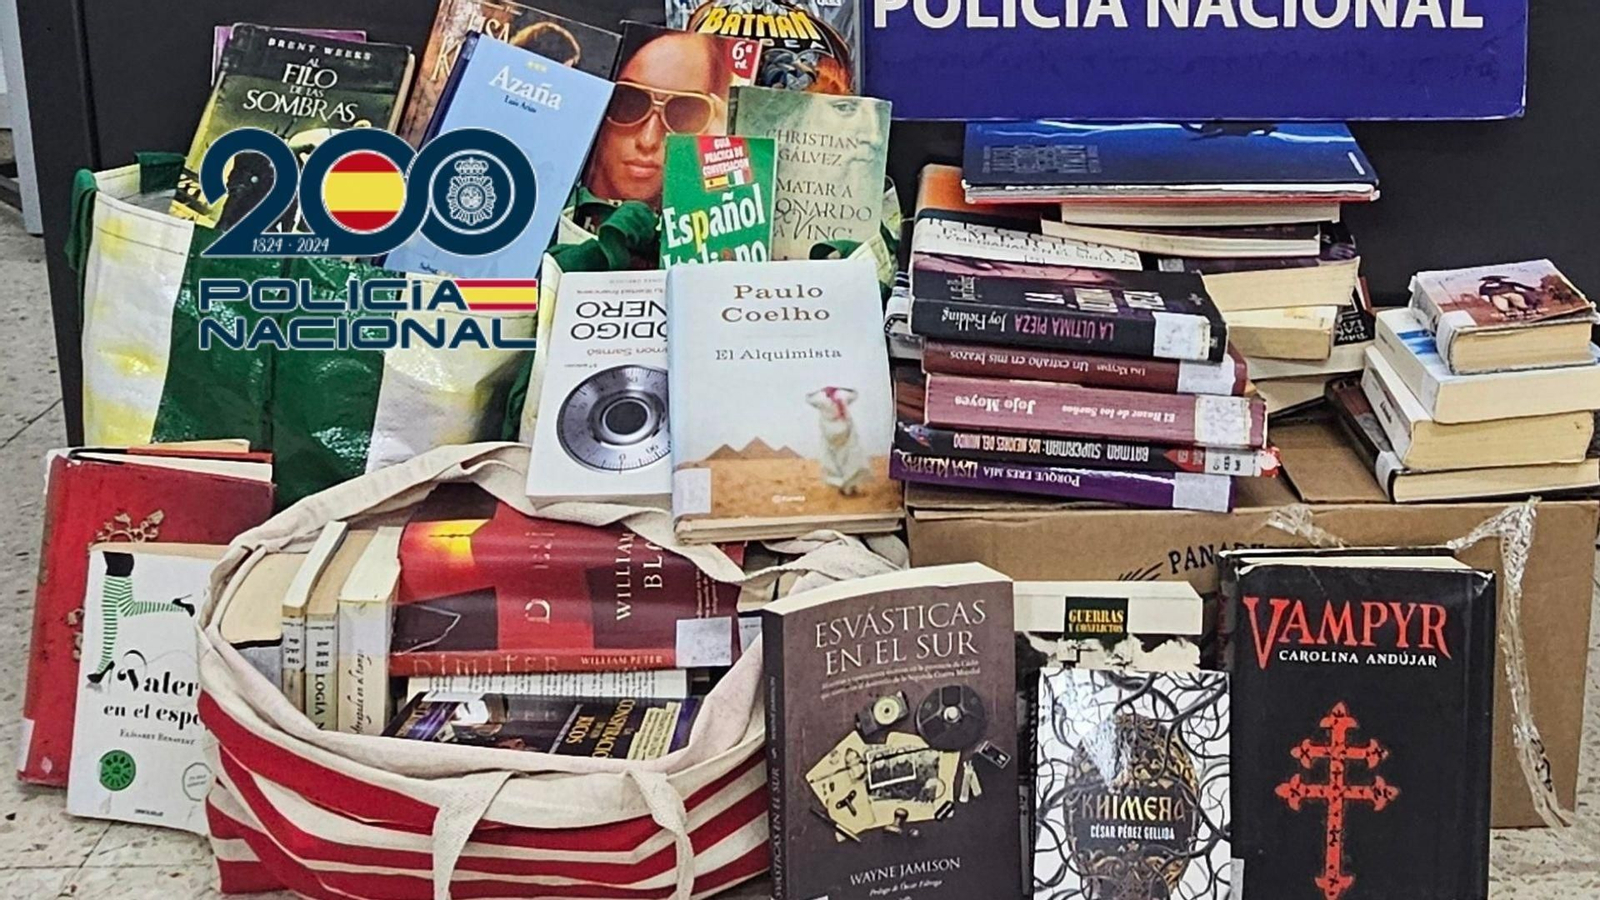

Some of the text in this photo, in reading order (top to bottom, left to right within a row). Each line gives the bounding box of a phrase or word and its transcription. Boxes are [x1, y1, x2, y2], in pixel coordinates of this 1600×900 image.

[1147, 0, 1484, 28] NACIONAL
[699, 7, 821, 40] BATMAN
[268, 37, 373, 61] BRENT WEEKS
[305, 57, 320, 67] AL
[282, 63, 338, 90] FILO
[306, 88, 325, 98] LAS
[489, 65, 562, 110] Azaña
[243, 90, 359, 122] SOMBRAS
[766, 128, 859, 150] CHRISTIAN
[778, 146, 843, 167] GÁLVEZ
[776, 177, 853, 198] MATAR A
[662, 182, 766, 254] Español
[793, 212, 853, 241] VINC
[733, 283, 824, 300] Paulo
[721, 306, 831, 323] Coelho
[941, 308, 1114, 343] LA ÚLTIMA PIEZA Joy Fielding
[715, 348, 842, 362] El Alquimista
[950, 349, 987, 366] brazos
[988, 354, 1009, 366] mis
[1011, 356, 1026, 366] en
[1028, 356, 1070, 371] extraño
[1072, 361, 1089, 373] Un
[954, 394, 1001, 414] Moyes
[1003, 396, 1036, 414] Jojo
[1117, 407, 1130, 420] de
[1106, 445, 1149, 463] BATMAN
[1006, 468, 1033, 482] ERES
[1035, 470, 1081, 488] PORQUE
[815, 599, 987, 649] ESVÁSTICAS
[1067, 608, 1125, 625] GUERRAS
[1243, 596, 1451, 670] VAMPYR
[580, 654, 628, 667] WILLIAM
[630, 654, 663, 665] PETER
[825, 629, 980, 676] EN EL SUR
[1279, 649, 1439, 668] CAROLINA ANDÚJAR
[103, 705, 126, 717] en
[133, 703, 150, 719] el
[1090, 822, 1116, 839] CÉSAR
[850, 857, 961, 886] WAYNE JAMISON
